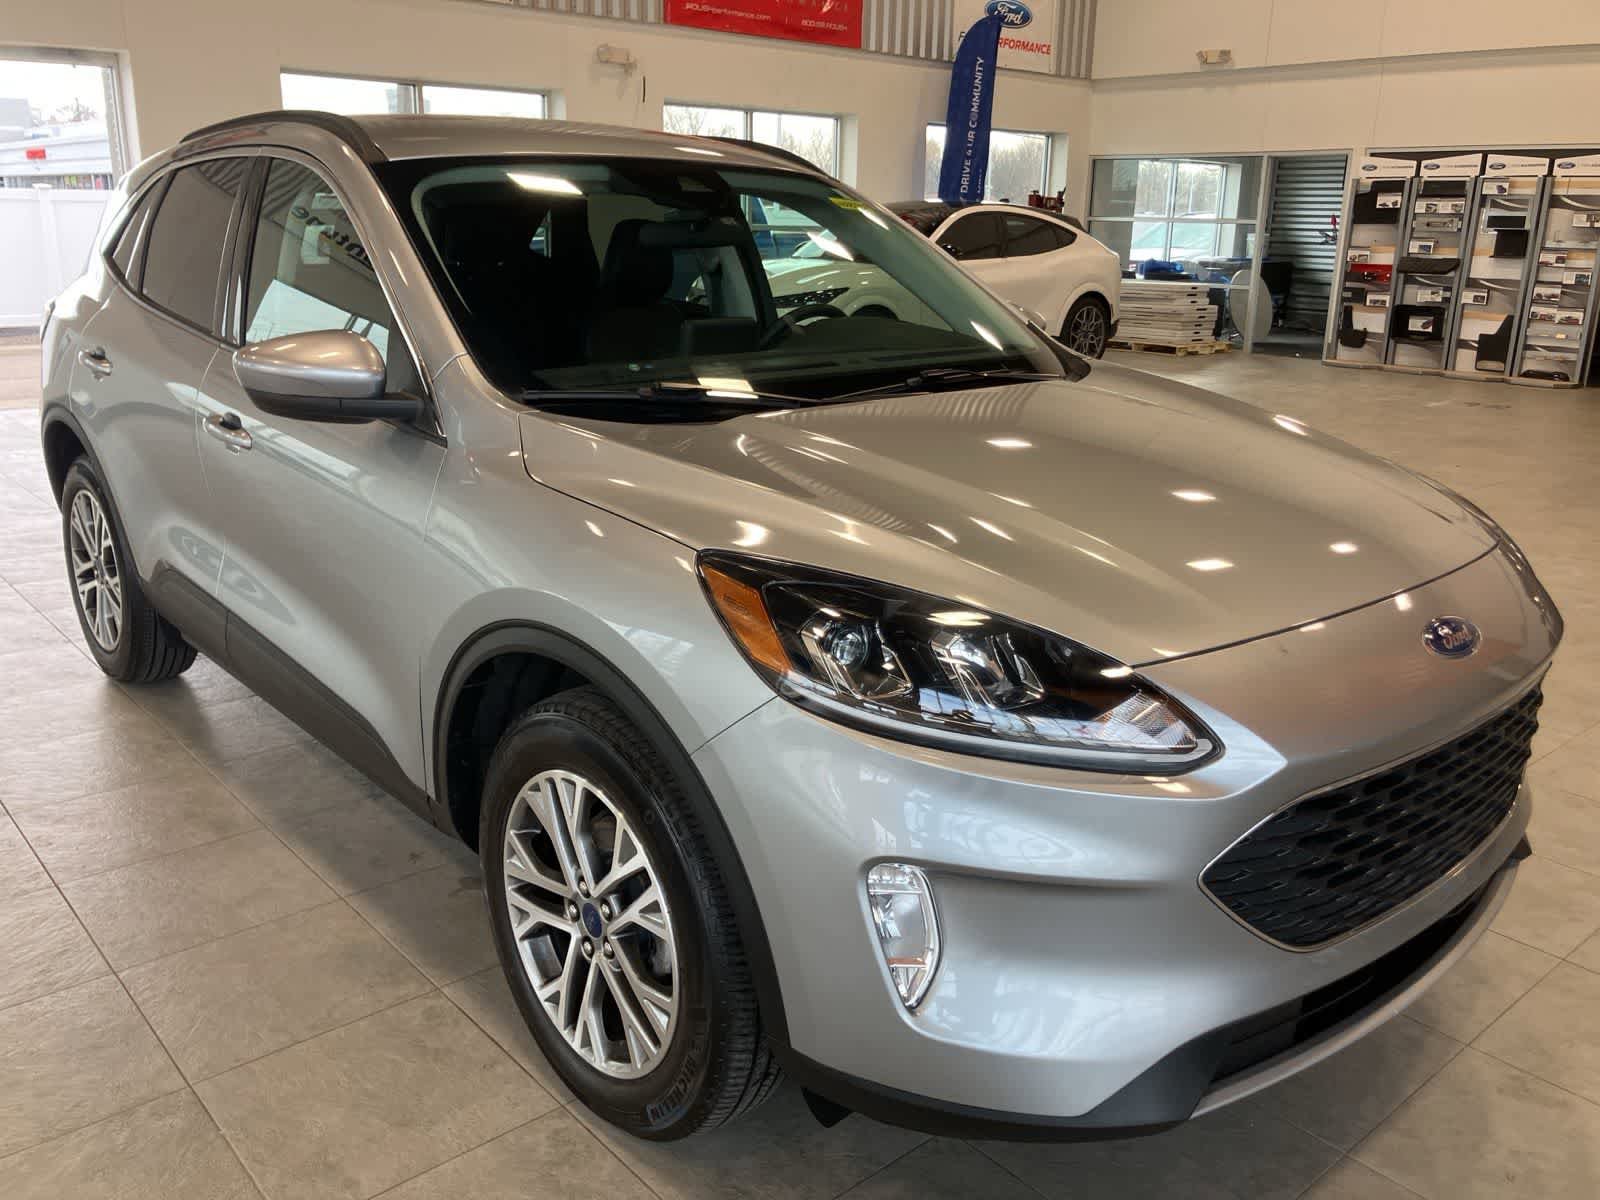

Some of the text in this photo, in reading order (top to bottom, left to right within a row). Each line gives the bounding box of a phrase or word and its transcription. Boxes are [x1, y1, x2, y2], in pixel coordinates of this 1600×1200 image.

[999, 37, 1052, 55] RFORMANCE
[969, 56, 984, 129] COMMUNITY
[967, 130, 976, 147] UR
[961, 160, 971, 193] DRIVE
